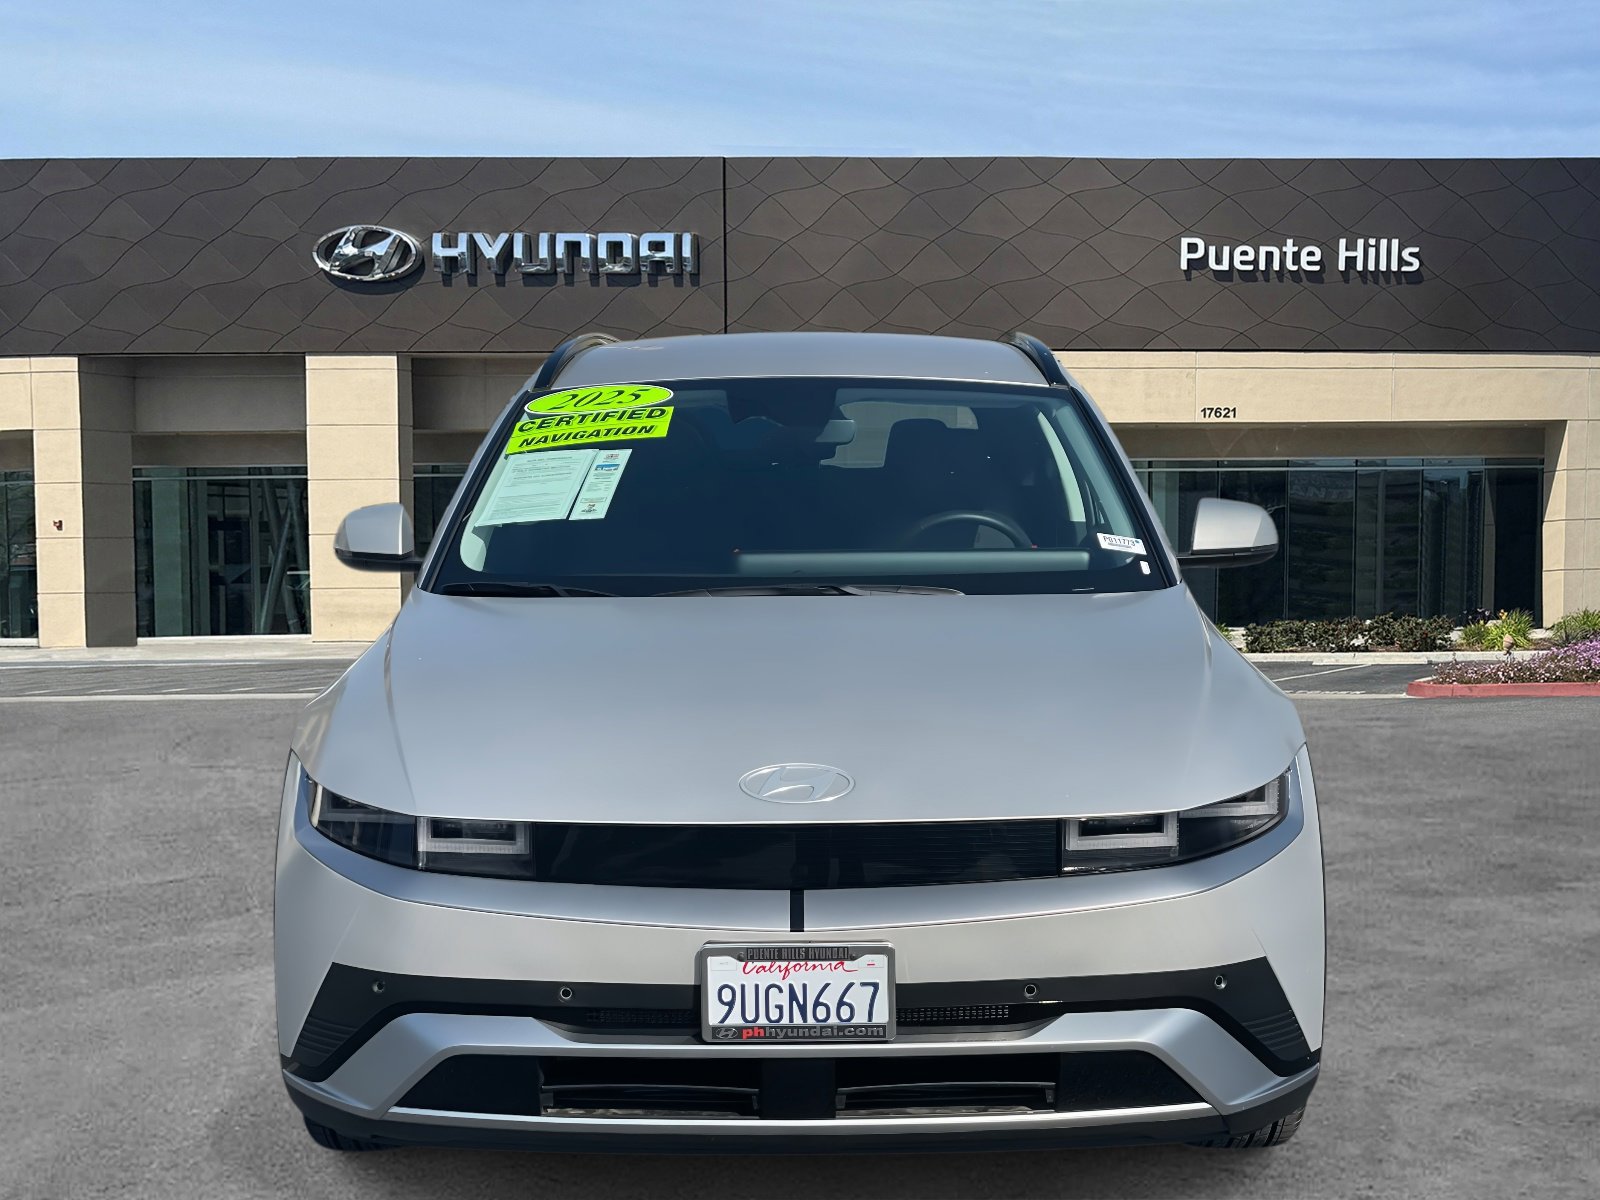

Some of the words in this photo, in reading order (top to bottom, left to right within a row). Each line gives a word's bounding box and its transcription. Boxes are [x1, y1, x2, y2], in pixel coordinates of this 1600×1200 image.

[432, 232, 698, 273] HYUNDAI
[1180, 237, 1322, 271] Puente
[1338, 238, 1421, 272] Hills
[548, 388, 651, 411] 2025
[517, 407, 667, 433] CERTIFIED
[1200, 406, 1237, 419] 17621
[518, 424, 656, 448] NAVIGATION
[747, 947, 779, 960] PUENTE
[782, 947, 806, 960] HILLS
[808, 947, 849, 960] HYUNDAI
[742, 960, 858, 981] California
[717, 981, 880, 1024] 9UGN667
[741, 1026, 884, 1040] phhyundai.com
